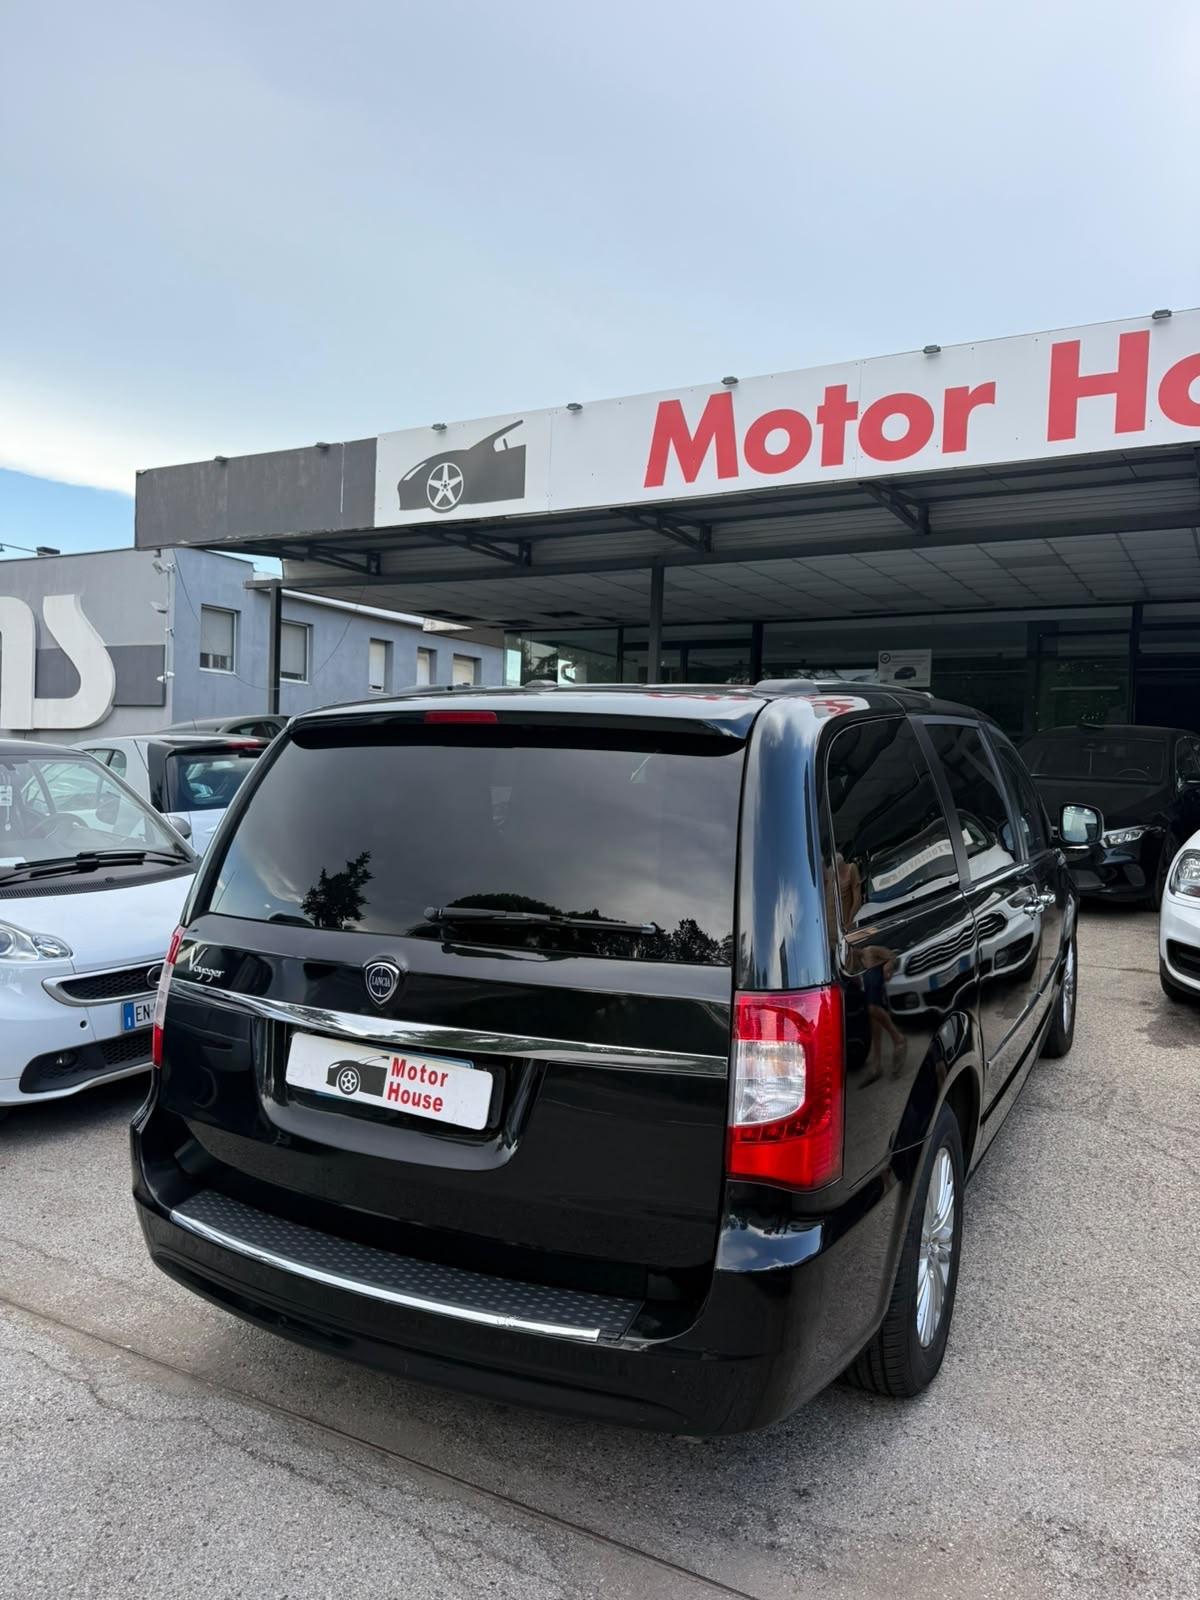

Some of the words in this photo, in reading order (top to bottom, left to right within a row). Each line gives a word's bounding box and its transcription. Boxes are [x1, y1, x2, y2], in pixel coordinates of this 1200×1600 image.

[643, 381, 996, 488] Motor
[188, 947, 225, 983] Voyager
[135, 1002, 156, 1022] EN
[391, 1057, 448, 1087] Motor
[387, 1081, 443, 1112] House
